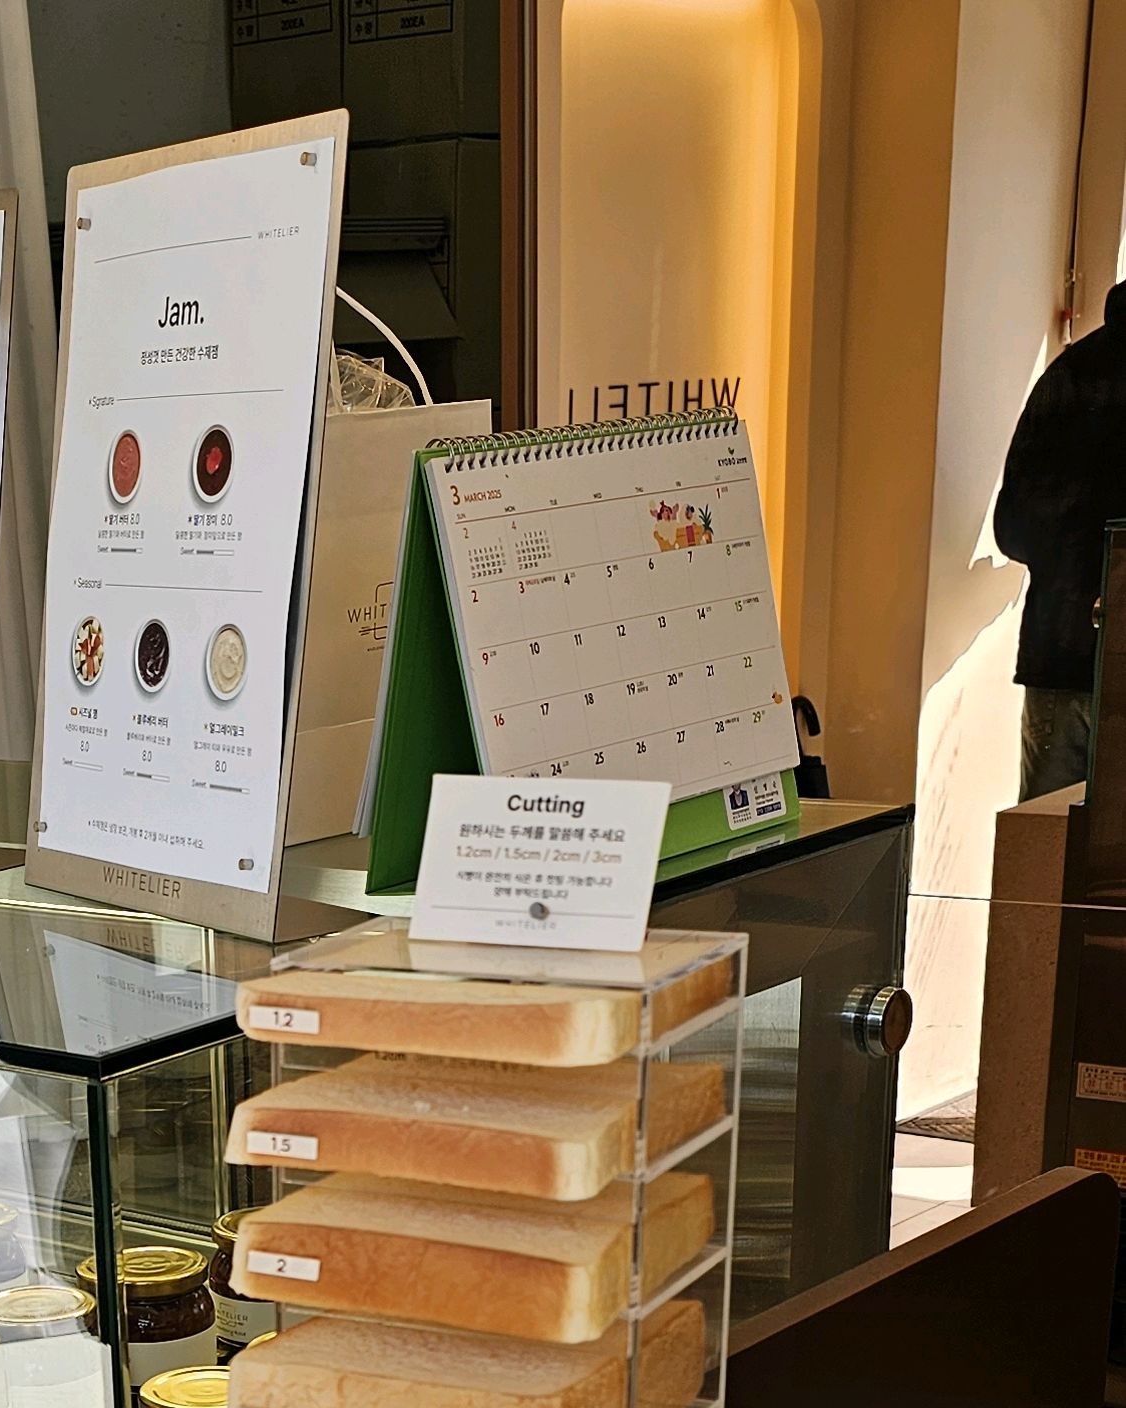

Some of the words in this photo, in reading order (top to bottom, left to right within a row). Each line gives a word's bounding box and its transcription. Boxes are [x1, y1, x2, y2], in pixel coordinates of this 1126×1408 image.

[258, 226, 300, 240] WHITELIER
[158, 296, 204, 328] Jam.
[175, 347, 196, 362] 건강한
[198, 344, 219, 360] 수제잼
[450, 485, 460, 505] 3
[464, 491, 486, 503] MARCH
[487, 489, 502, 500] 2025
[221, 514, 233, 525] 8.0
[726, 544, 731, 556] 8
[688, 551, 693, 563] 7
[649, 558, 654, 570] 6
[607, 565, 613, 577] 5
[564, 573, 570, 585] 4
[518, 581, 525, 594] 3
[471, 590, 479, 603] 2
[735, 601, 742, 612] 15
[697, 608, 706, 620] 14
[658, 616, 666, 628] 13
[617, 625, 626, 637] 12
[574, 633, 582, 647] 11
[529, 642, 540, 655] 10
[482, 653, 489, 665] 9
[744, 656, 752, 668] 22
[706, 665, 714, 677] 21
[667, 674, 678, 686] 20
[626, 683, 636, 695] 19
[584, 693, 594, 706] 18
[540, 703, 549, 716] 17
[493, 713, 505, 727] 16
[753, 711, 761, 723] 29
[715, 721, 724, 733] 28
[676, 731, 686, 744] 27
[80, 741, 90, 752] 8.0
[636, 741, 646, 755] 26
[142, 750, 152, 762] 8.0
[594, 752, 605, 765] 25
[215, 760, 227, 773] 8.0
[551, 763, 562, 777] 24
[507, 794, 585, 818] Cutting
[459, 824, 506, 838] 원하시는
[509, 826, 544, 839] 두께를
[548, 827, 584, 841] 말씀해
[589, 829, 625, 842] 주세요
[456, 846, 491, 858] 1.2cm
[504, 848, 541, 860] 1.5cm
[553, 849, 580, 862] 2cm
[592, 851, 622, 864] 3cm
[103, 865, 181, 899] WHITELIER
[273, 1011, 294, 1028] 1.2
[271, 1138, 291, 1153] 1.5
[276, 1259, 287, 1273] 2
